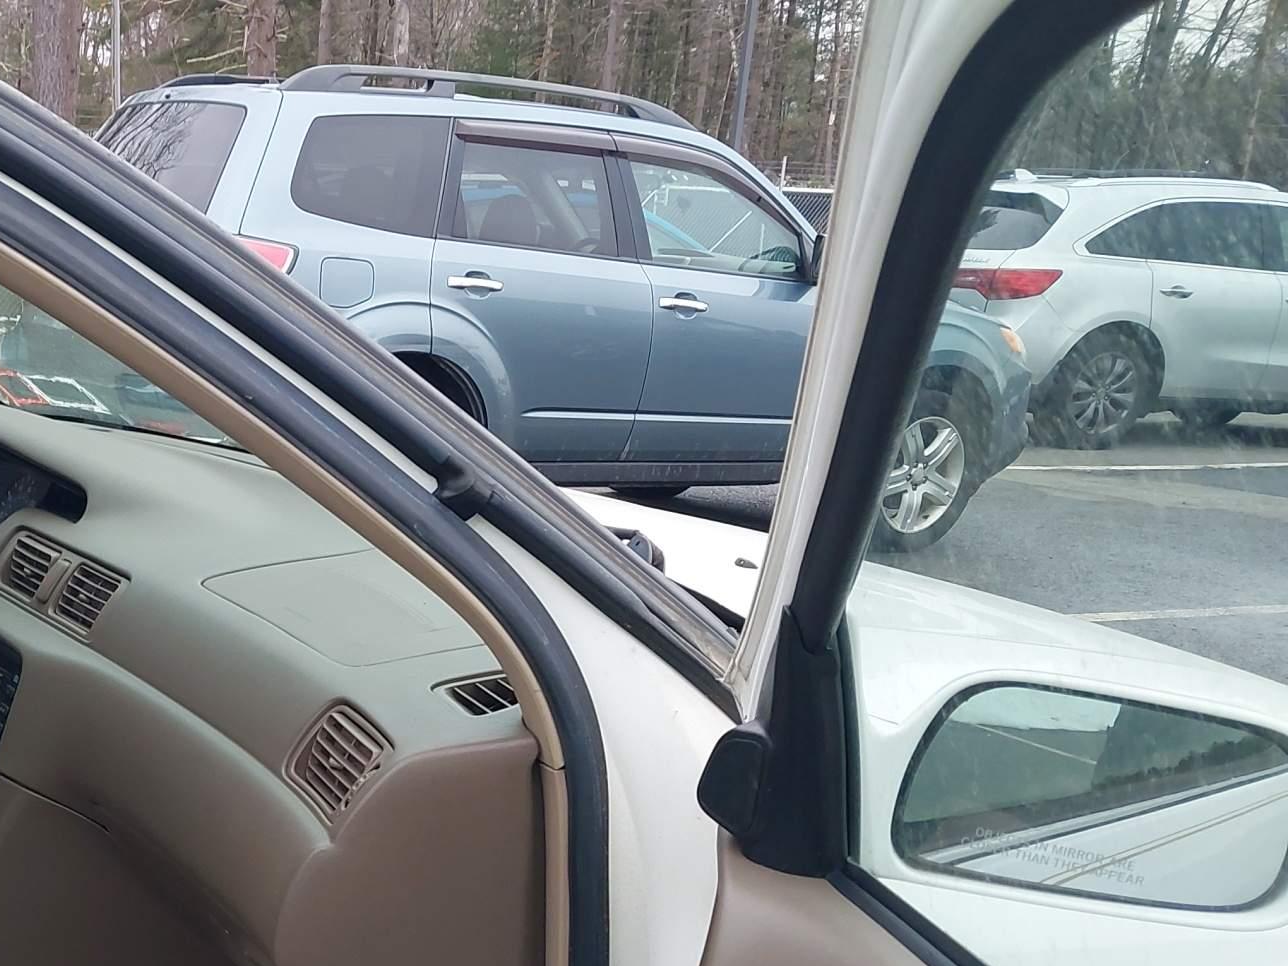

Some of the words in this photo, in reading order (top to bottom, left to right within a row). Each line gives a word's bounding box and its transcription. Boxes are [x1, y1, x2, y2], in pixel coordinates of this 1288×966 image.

[1014, 849, 1050, 865] THAN
[1034, 842, 1049, 853] IN
[1051, 843, 1105, 864] MIRROR
[1110, 856, 1136, 873] ARE
